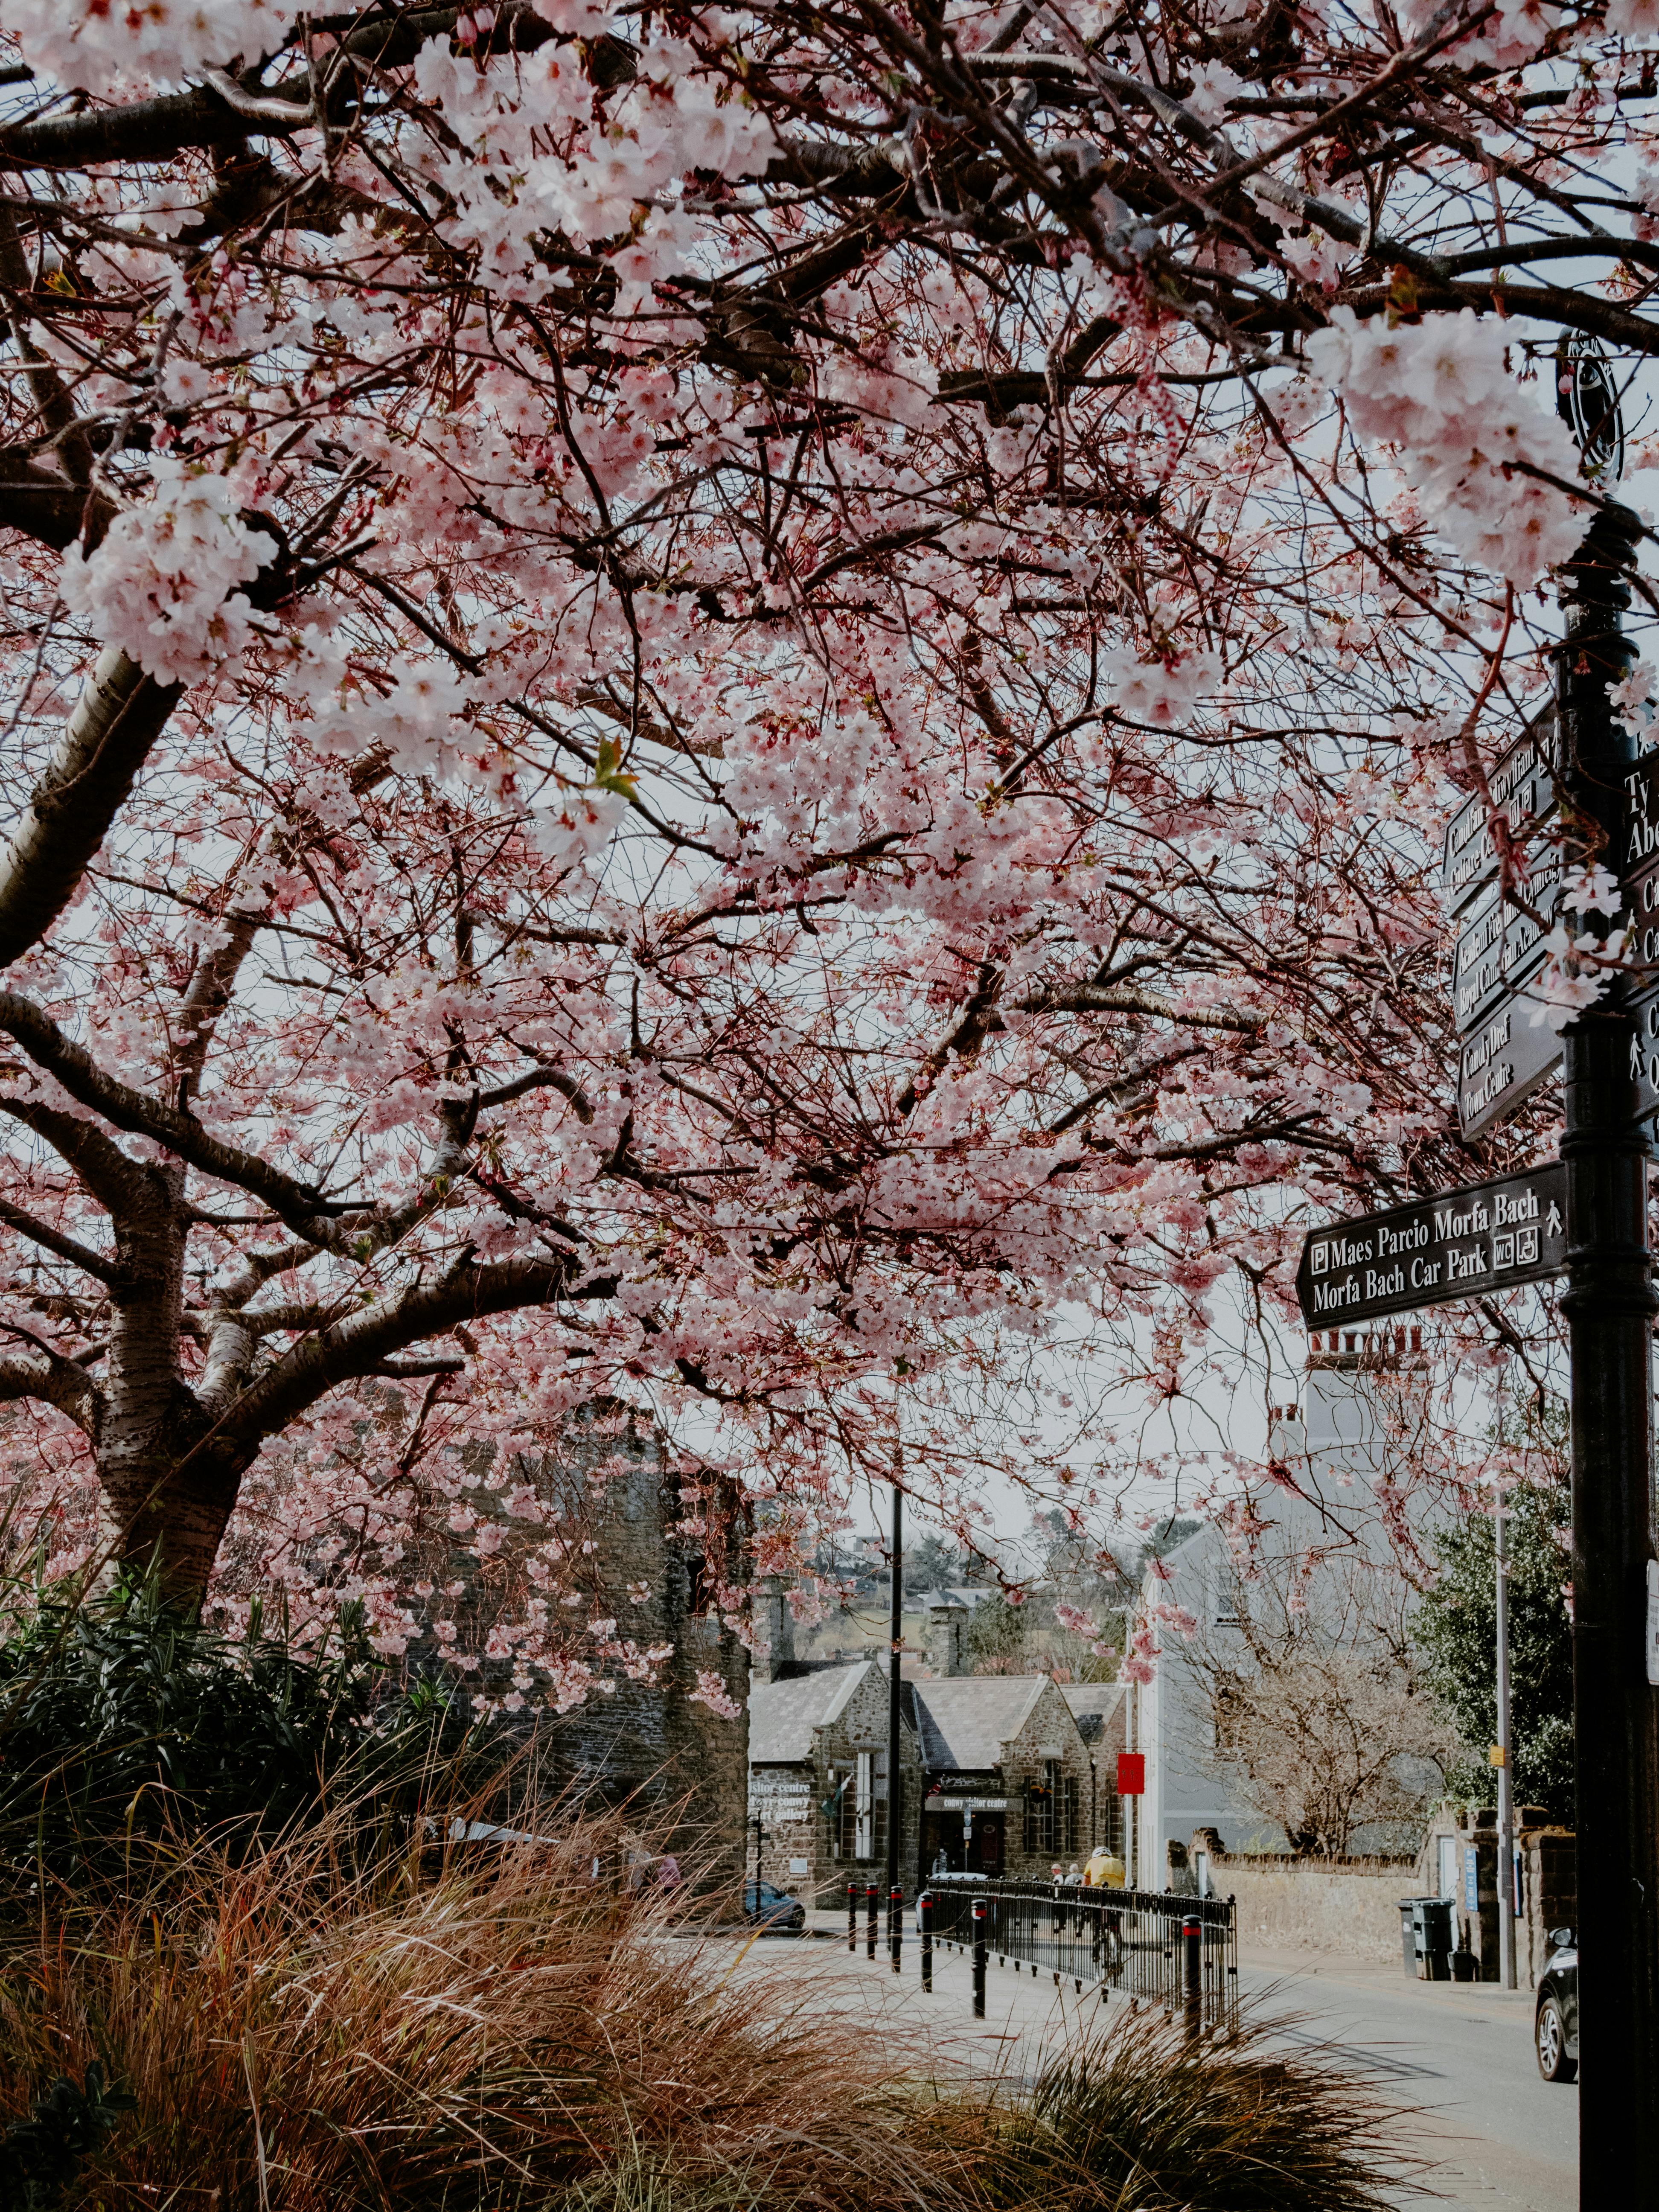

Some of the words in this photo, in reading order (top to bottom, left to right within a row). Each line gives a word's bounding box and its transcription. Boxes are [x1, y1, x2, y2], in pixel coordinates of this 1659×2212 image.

[1624, 771, 1650, 819] Ty
[1449, 805, 1484, 857] Canolfan
[1450, 849, 1480, 896] Culture
[1459, 921, 1487, 976] Academi
[1459, 971, 1479, 1016] Royal
[1464, 1035, 1486, 1079] Canol
[1485, 1038, 1491, 1066] y
[1490, 1012, 1510, 1056] Dref
[1464, 1088, 1485, 1121] Town
[1485, 1063, 1511, 1102] Centre
[1331, 1238, 1373, 1269] Maes
[1377, 1219, 1429, 1257] Parcio
[1434, 1201, 1490, 1243] Morfa
[1493, 1188, 1540, 1227] Bach
[1314, 1274, 1361, 1313] Morfa
[1365, 1264, 1405, 1300] Bach
[1411, 1257, 1441, 1289] Car
[1447, 1243, 1488, 1281] Park
[1496, 1242, 1511, 1262] WC
[748, 1782, 775, 1793] isitor
[778, 1783, 811, 1793] centre
[777, 1797, 810, 1808] conwy
[944, 1799, 964, 1809] conwy
[987, 1798, 1007, 1807] centre
[775, 1808, 809, 1822] gallery
